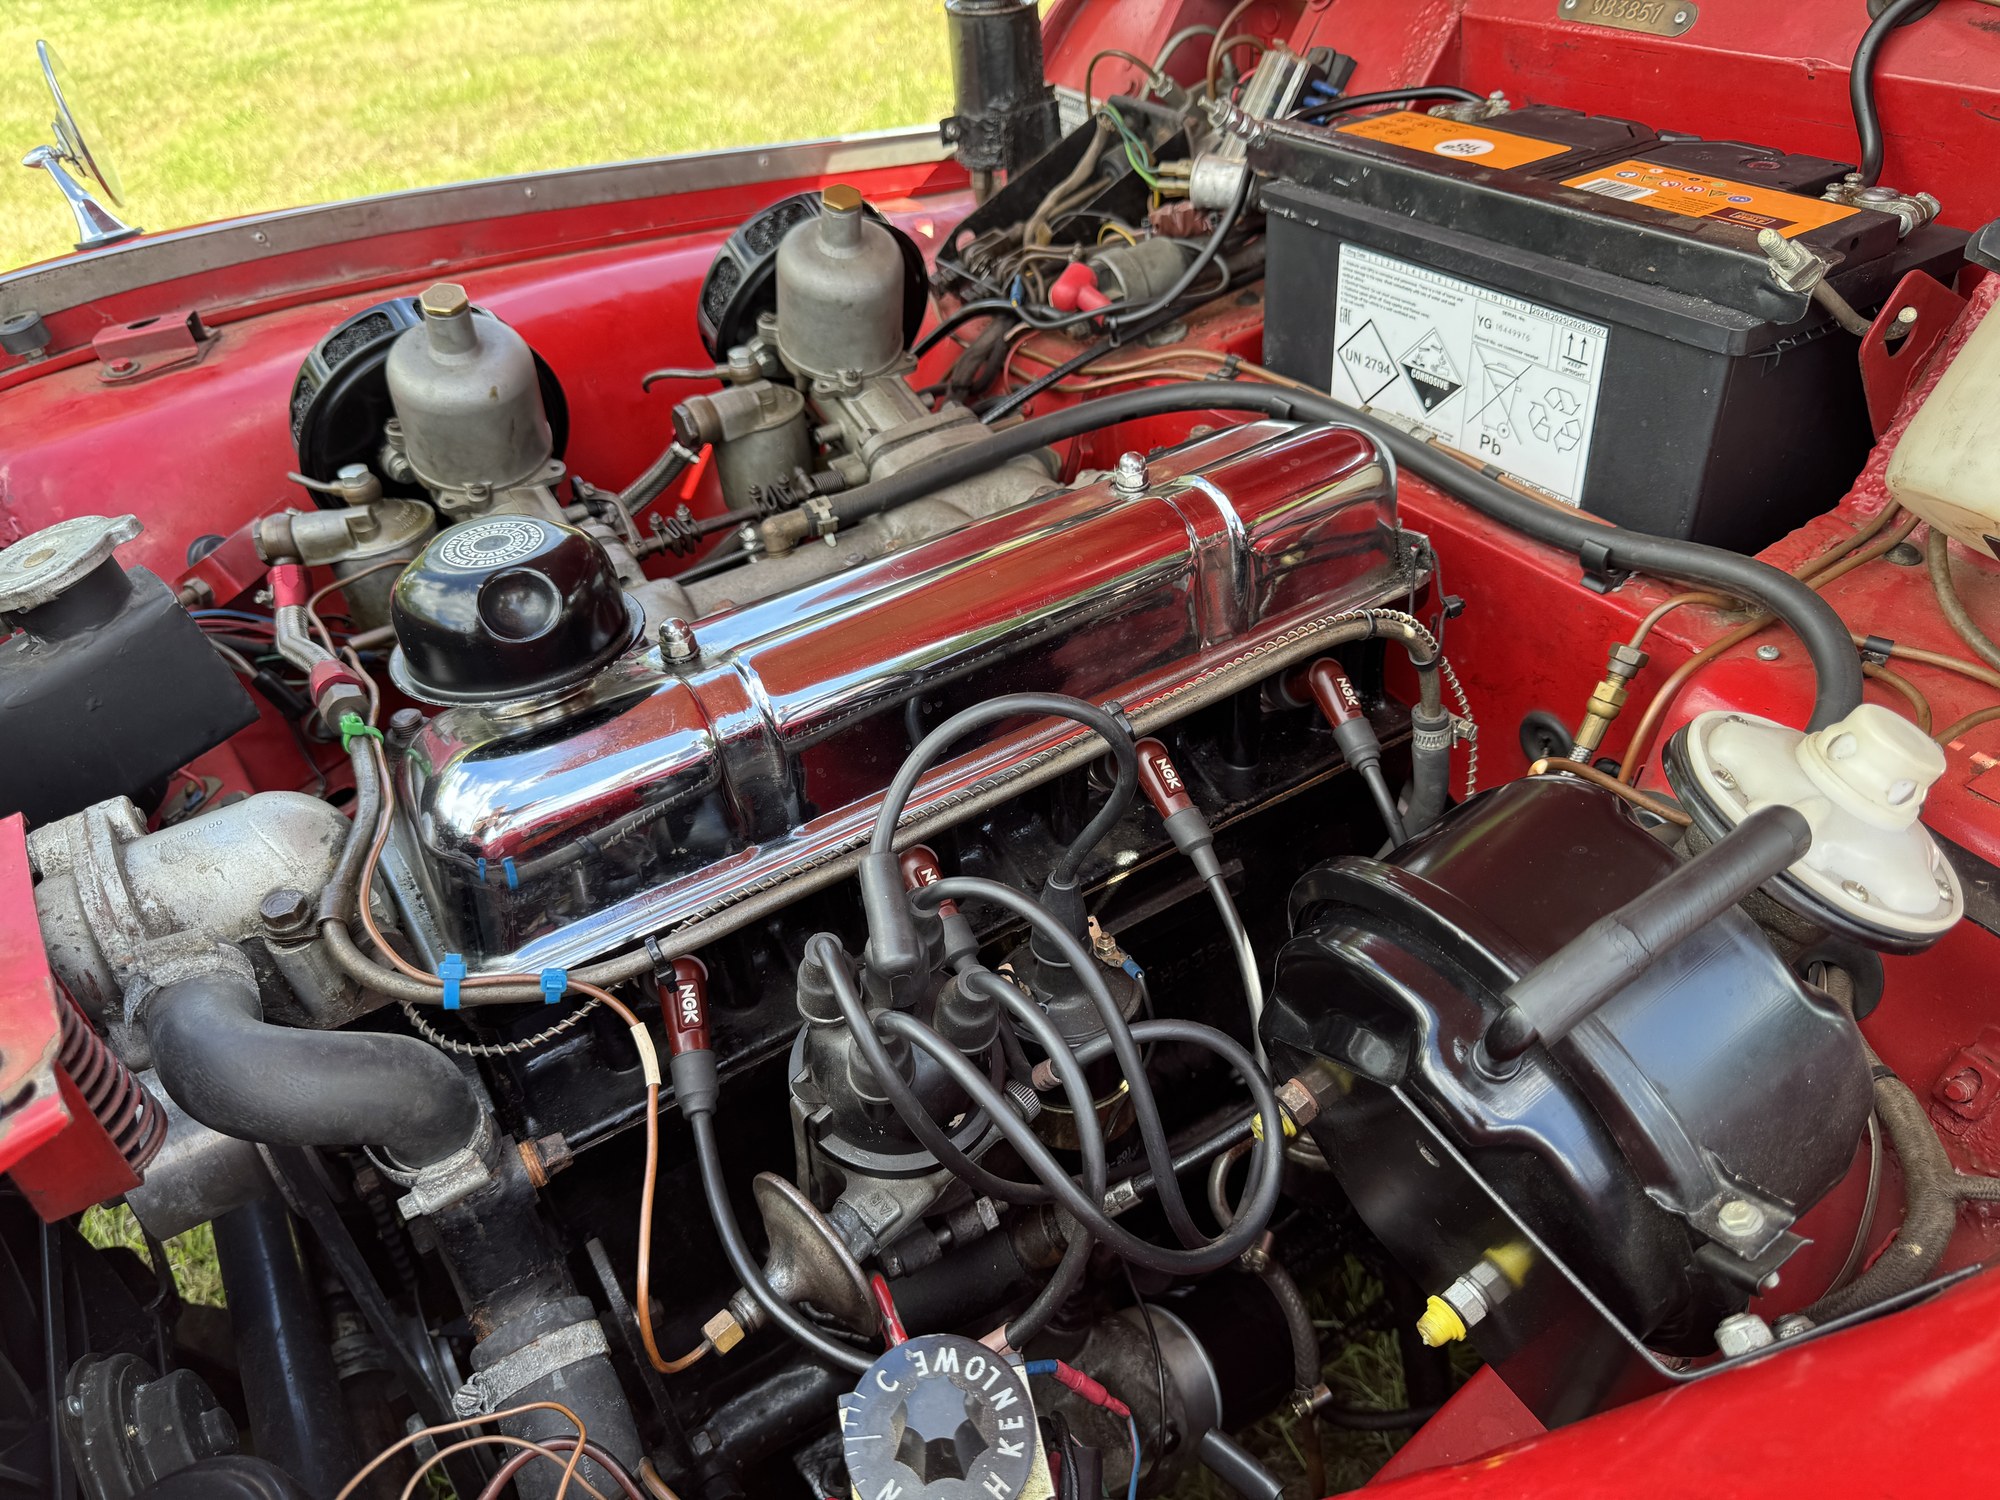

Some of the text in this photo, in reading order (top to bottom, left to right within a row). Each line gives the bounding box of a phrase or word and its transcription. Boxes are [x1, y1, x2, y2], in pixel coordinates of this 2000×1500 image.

[1477, 315, 1492, 330] YG
[1588, 324, 1606, 336] 2027
[1345, 347, 1391, 377] UN 2794
[1410, 368, 1451, 391] CORROSIVE
[1479, 433, 1501, 456] Pb
[476, 552, 521, 566] SHELL
[1336, 677, 1359, 706] NGK
[1156, 757, 1182, 790] NGK
[679, 984, 700, 1024] NGK
[875, 1369, 900, 1393] C
[912, 1346, 1025, 1459] KENLOWE
